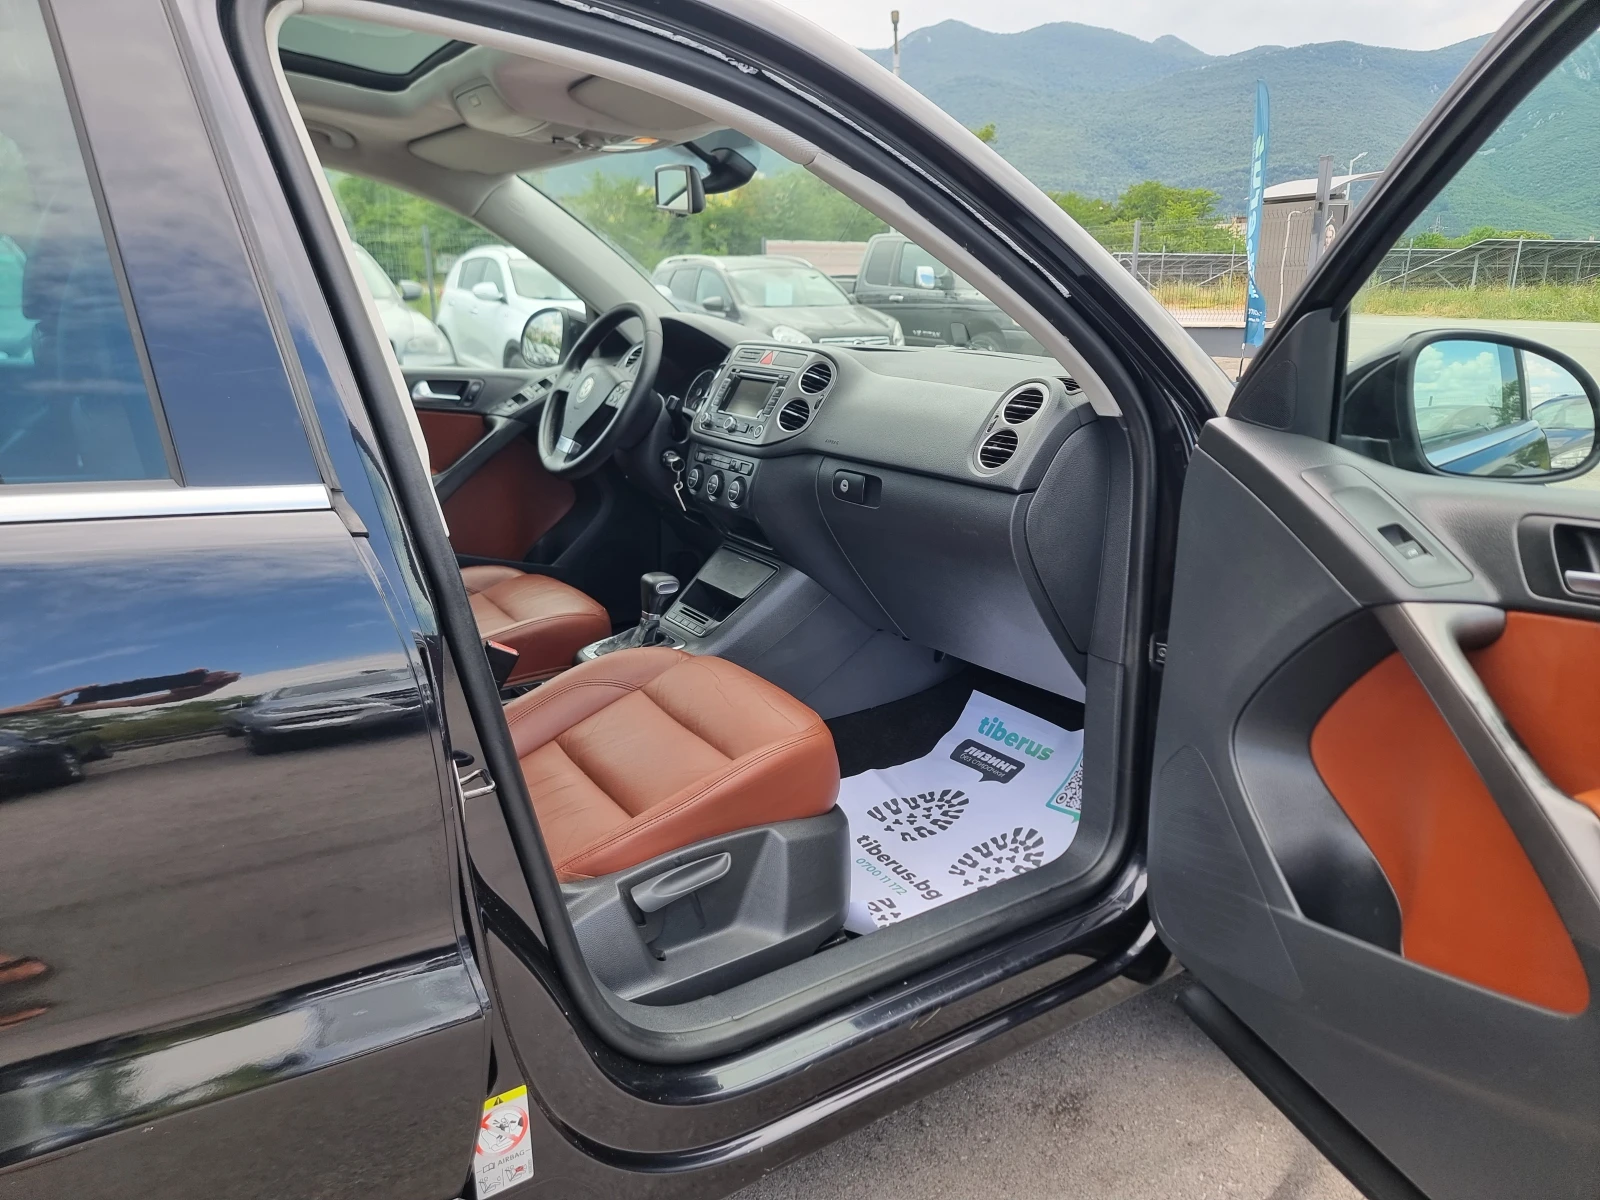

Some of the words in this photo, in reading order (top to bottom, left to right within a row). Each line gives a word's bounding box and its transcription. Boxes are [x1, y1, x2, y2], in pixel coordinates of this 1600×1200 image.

[959, 752, 972, 763] без
[978, 716, 1055, 761] tiberus
[855, 857, 882, 877] 0700
[879, 875, 892, 884] 11
[888, 881, 908, 896] 172
[856, 834, 944, 901] tiberus.bg
[497, 1149, 525, 1166] AIRBAG
